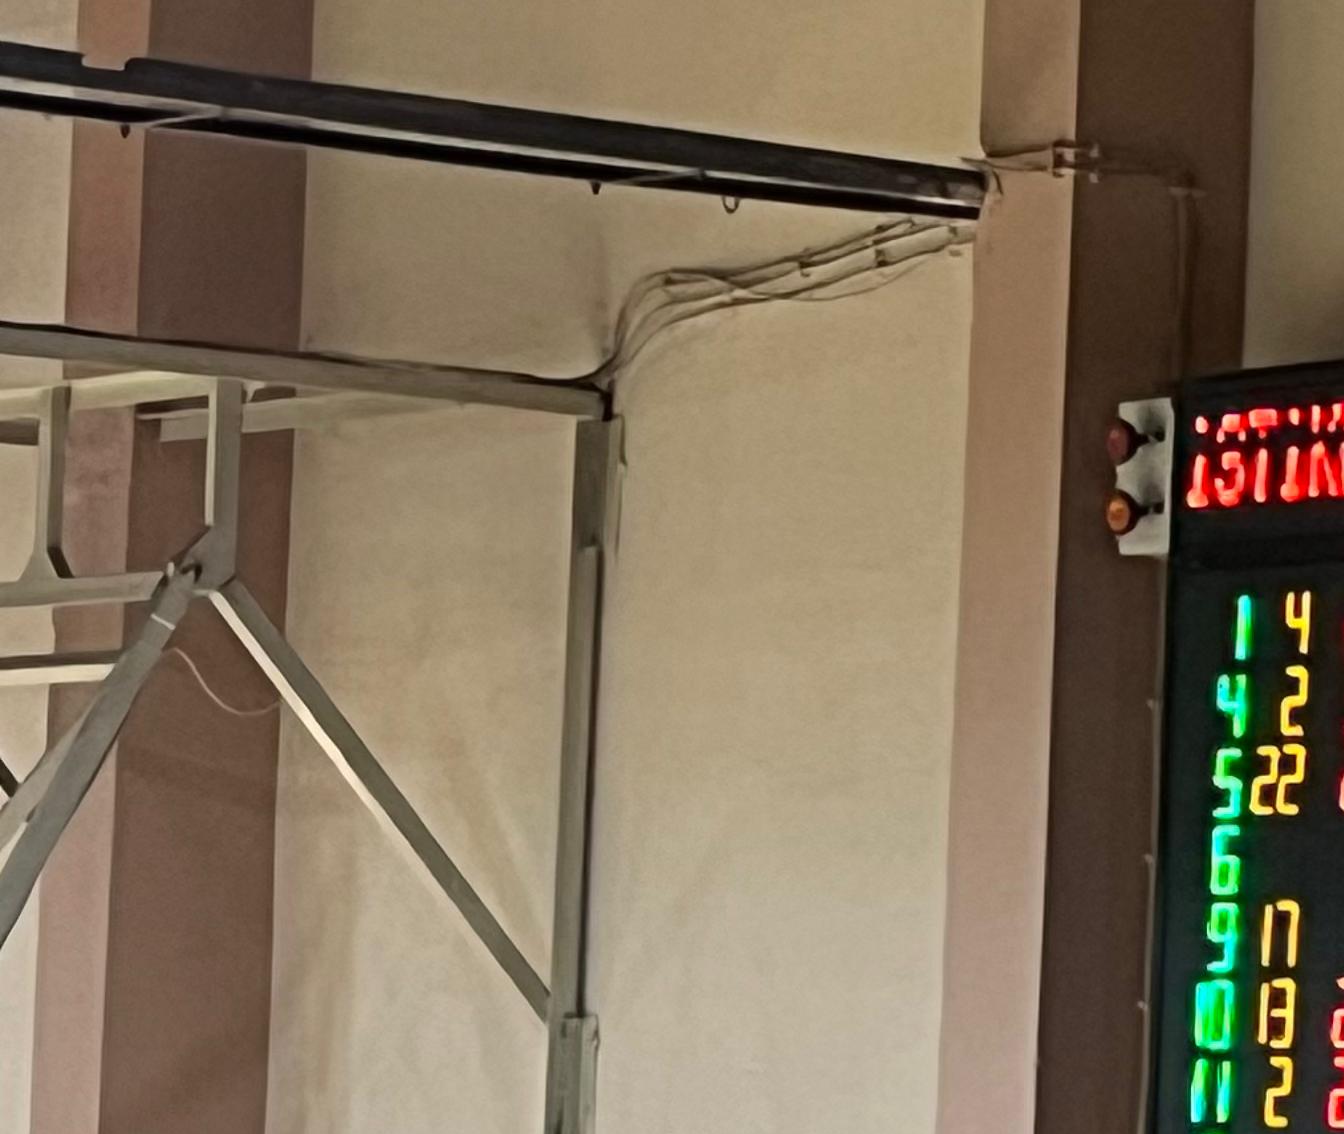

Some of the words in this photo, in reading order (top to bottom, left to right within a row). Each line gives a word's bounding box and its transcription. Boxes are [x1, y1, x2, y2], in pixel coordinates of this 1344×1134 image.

[1234, 595, 1252, 660] 1
[1286, 590, 1310, 653] 4
[1217, 673, 1246, 736] 4
[1281, 665, 1308, 736] 2
[1212, 747, 1242, 818] 5
[1250, 743, 1306, 815] 22
[1210, 824, 1240, 896] 6
[1206, 903, 1237, 972] 9
[1262, 900, 1299, 967] 17
[1258, 978, 1295, 1048] 13
[1190, 1059, 1231, 1123] 11
[1265, 1056, 1294, 1128] 2
